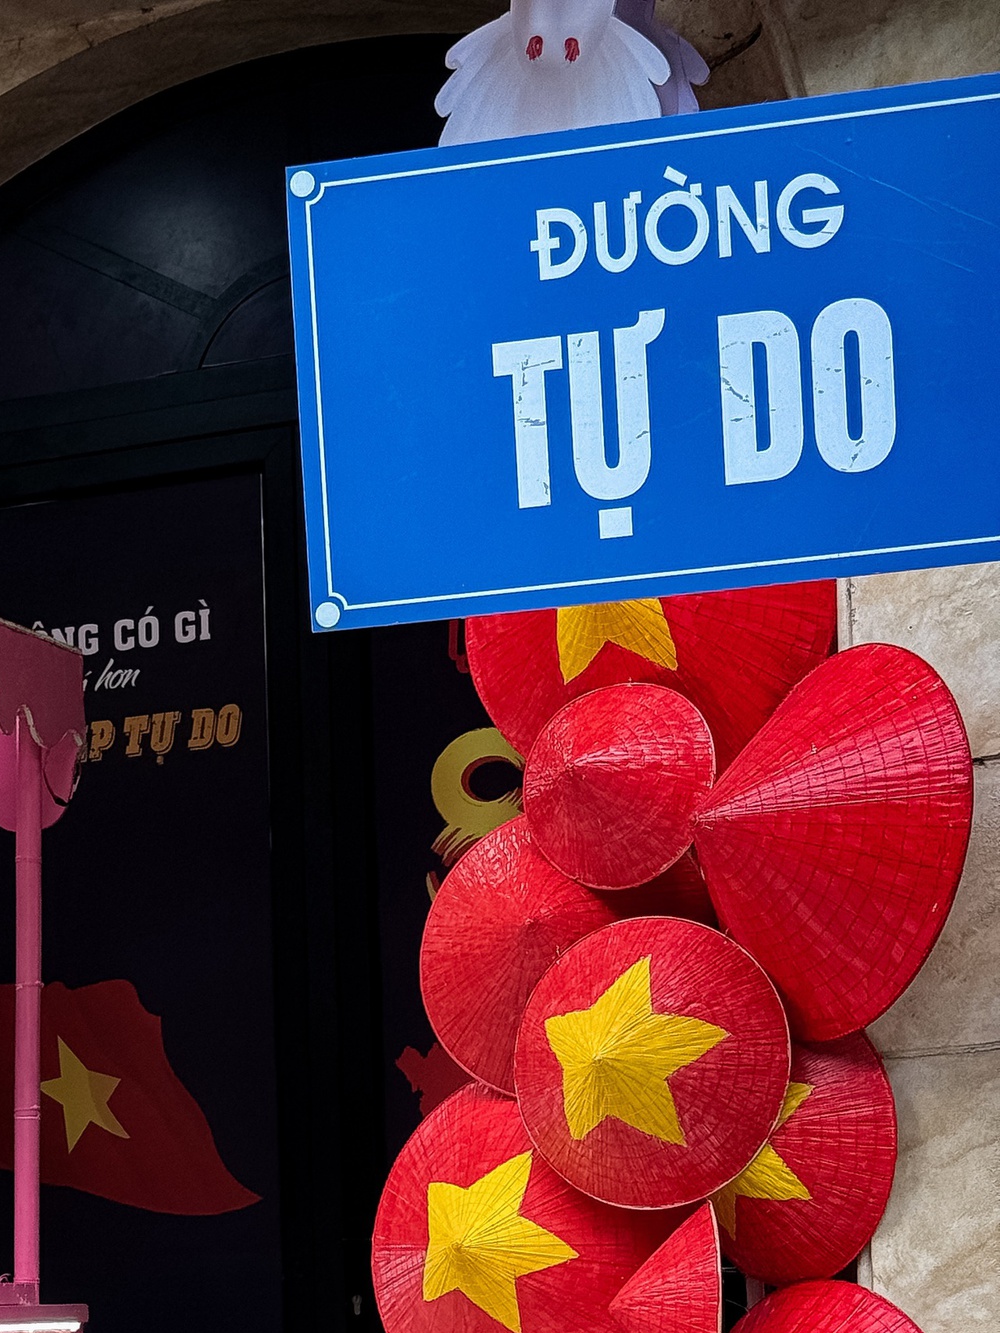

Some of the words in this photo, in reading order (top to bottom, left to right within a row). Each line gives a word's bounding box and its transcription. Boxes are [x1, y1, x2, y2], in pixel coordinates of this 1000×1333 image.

[530, 166, 845, 281] ĐƯỜNG
[491, 308, 666, 540] TỰ
[717, 298, 897, 487] DO
[113, 606, 160, 651] CÓ
[174, 599, 211, 643] GÌ
[123, 710, 182, 765] TỰ
[187, 703, 243, 752] DO
